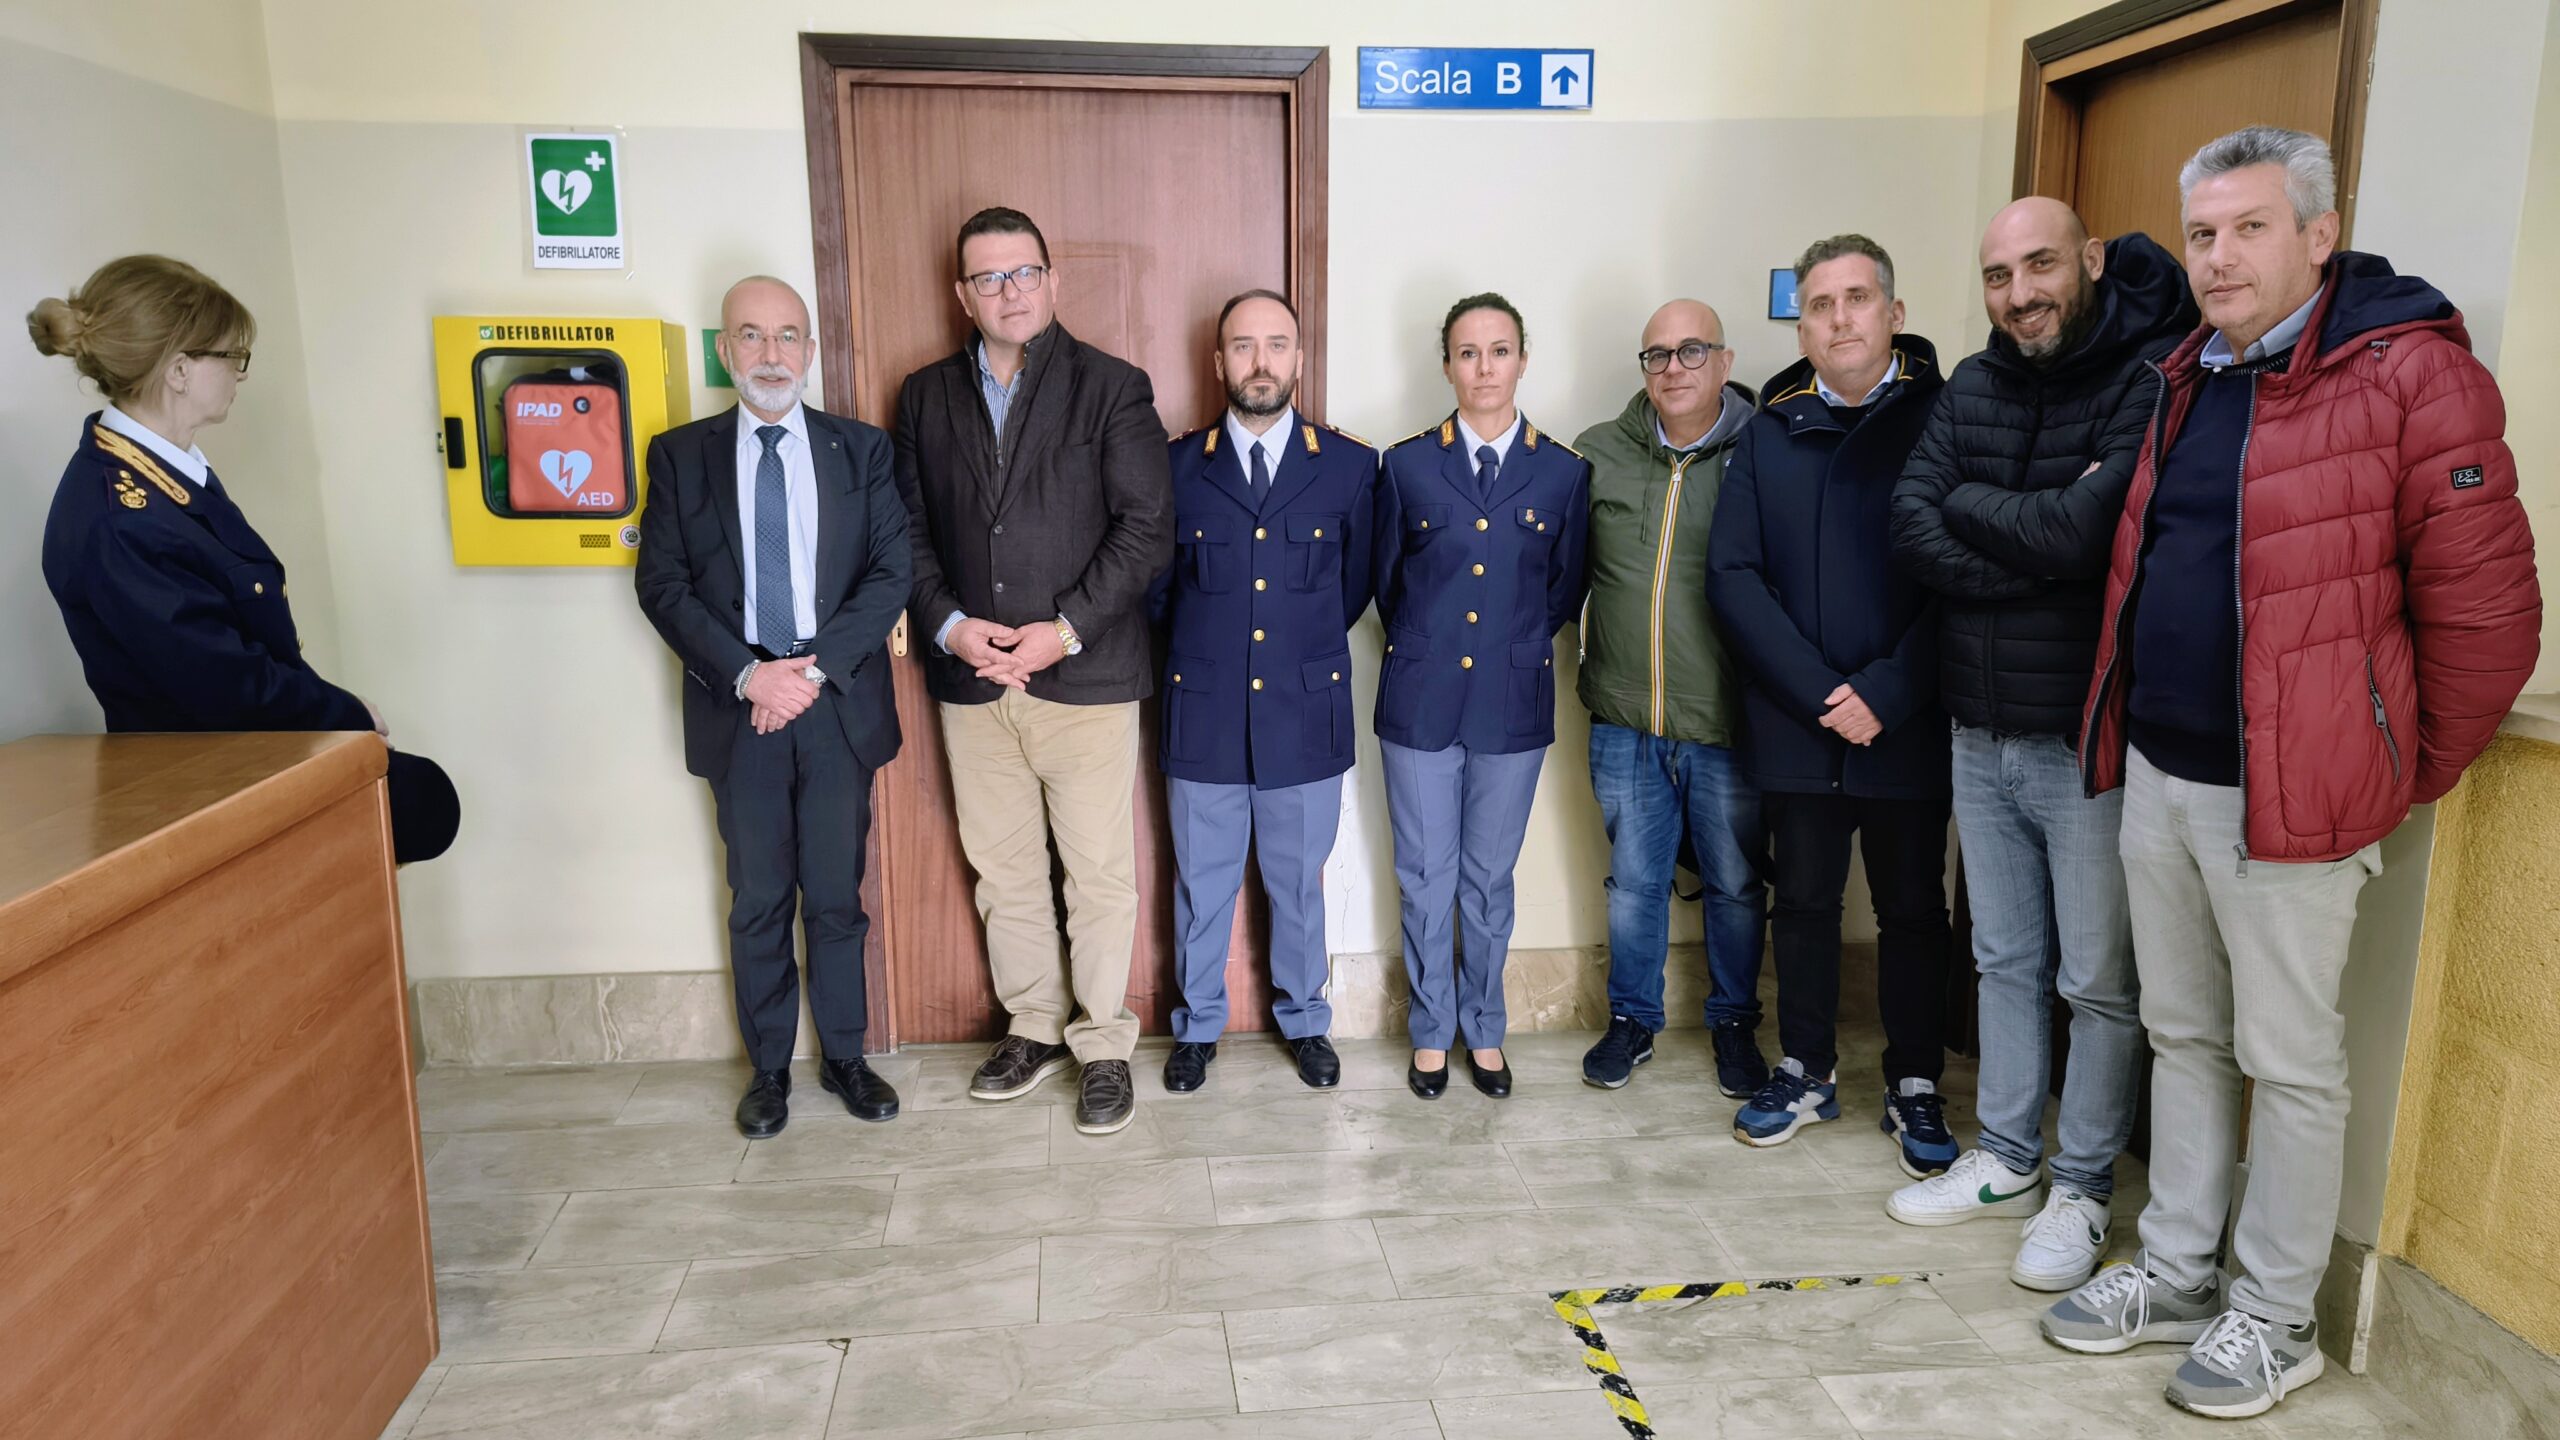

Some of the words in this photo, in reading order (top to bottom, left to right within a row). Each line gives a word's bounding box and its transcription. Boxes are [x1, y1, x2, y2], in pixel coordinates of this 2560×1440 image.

[1375, 60, 1472, 95] Scala
[1496, 62, 1522, 95] B
[538, 245, 621, 259] DEFIBRILLATORE
[496, 325, 615, 342] DEFIBRILLATOR
[516, 402, 563, 417] IPAD
[577, 491, 615, 506] AED
